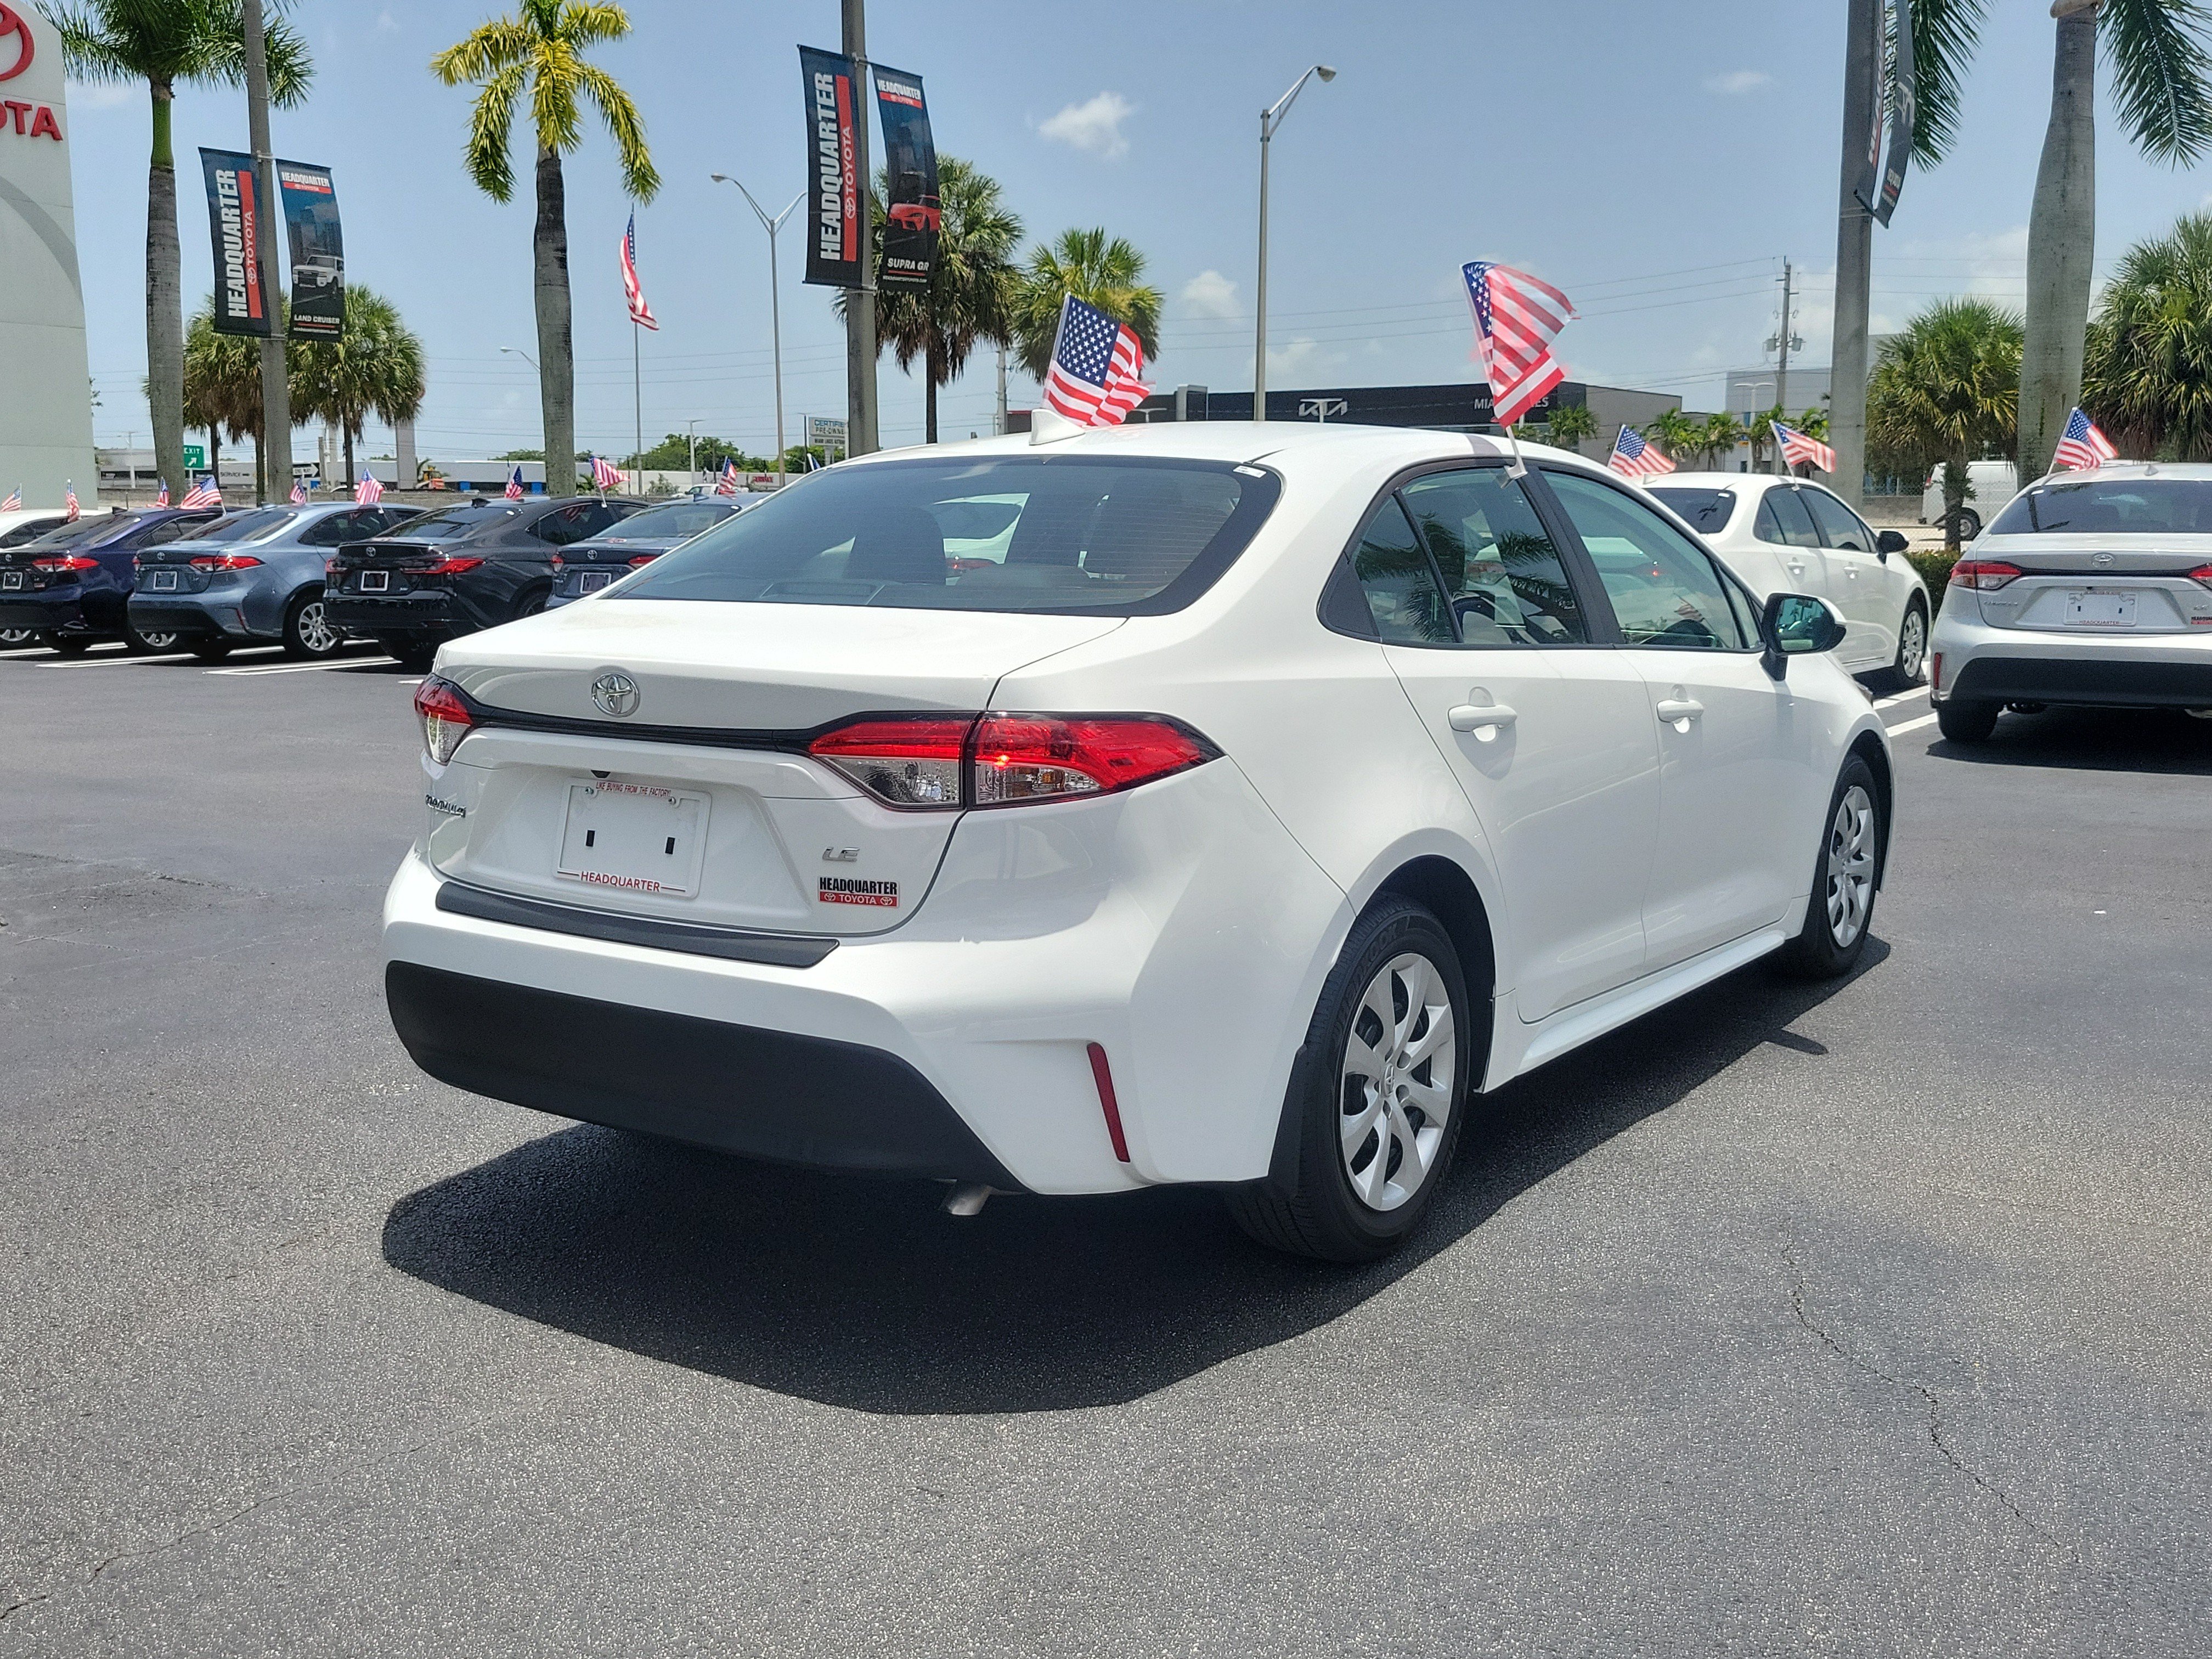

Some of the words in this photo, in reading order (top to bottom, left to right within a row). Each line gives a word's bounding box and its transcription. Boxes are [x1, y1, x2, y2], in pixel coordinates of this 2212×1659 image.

[815, 73, 843, 260] HEADQUARTER
[843, 126, 854, 195] TOYOTA
[281, 172, 330, 187] HEADQUARTER
[216, 170, 249, 317] HEADQUARTER
[245, 211, 254, 266] TOYOTA
[887, 257, 916, 270] SUPRA
[917, 261, 929, 271] GR
[294, 314, 312, 322] LAND
[313, 315, 340, 324] CRUISER
[1474, 398, 1494, 410] MIA
[815, 419, 845, 427] CERTIFIE
[596, 781, 605, 790] LIKE
[606, 782, 623, 792] BUYING
[624, 785, 638, 793] FROM
[640, 786, 648, 795] THE
[822, 847, 860, 862] LE
[580, 871, 661, 892] HEADQUARTER
[820, 877, 898, 895] HEADQUARTER
[839, 894, 877, 904] TOYOTA
